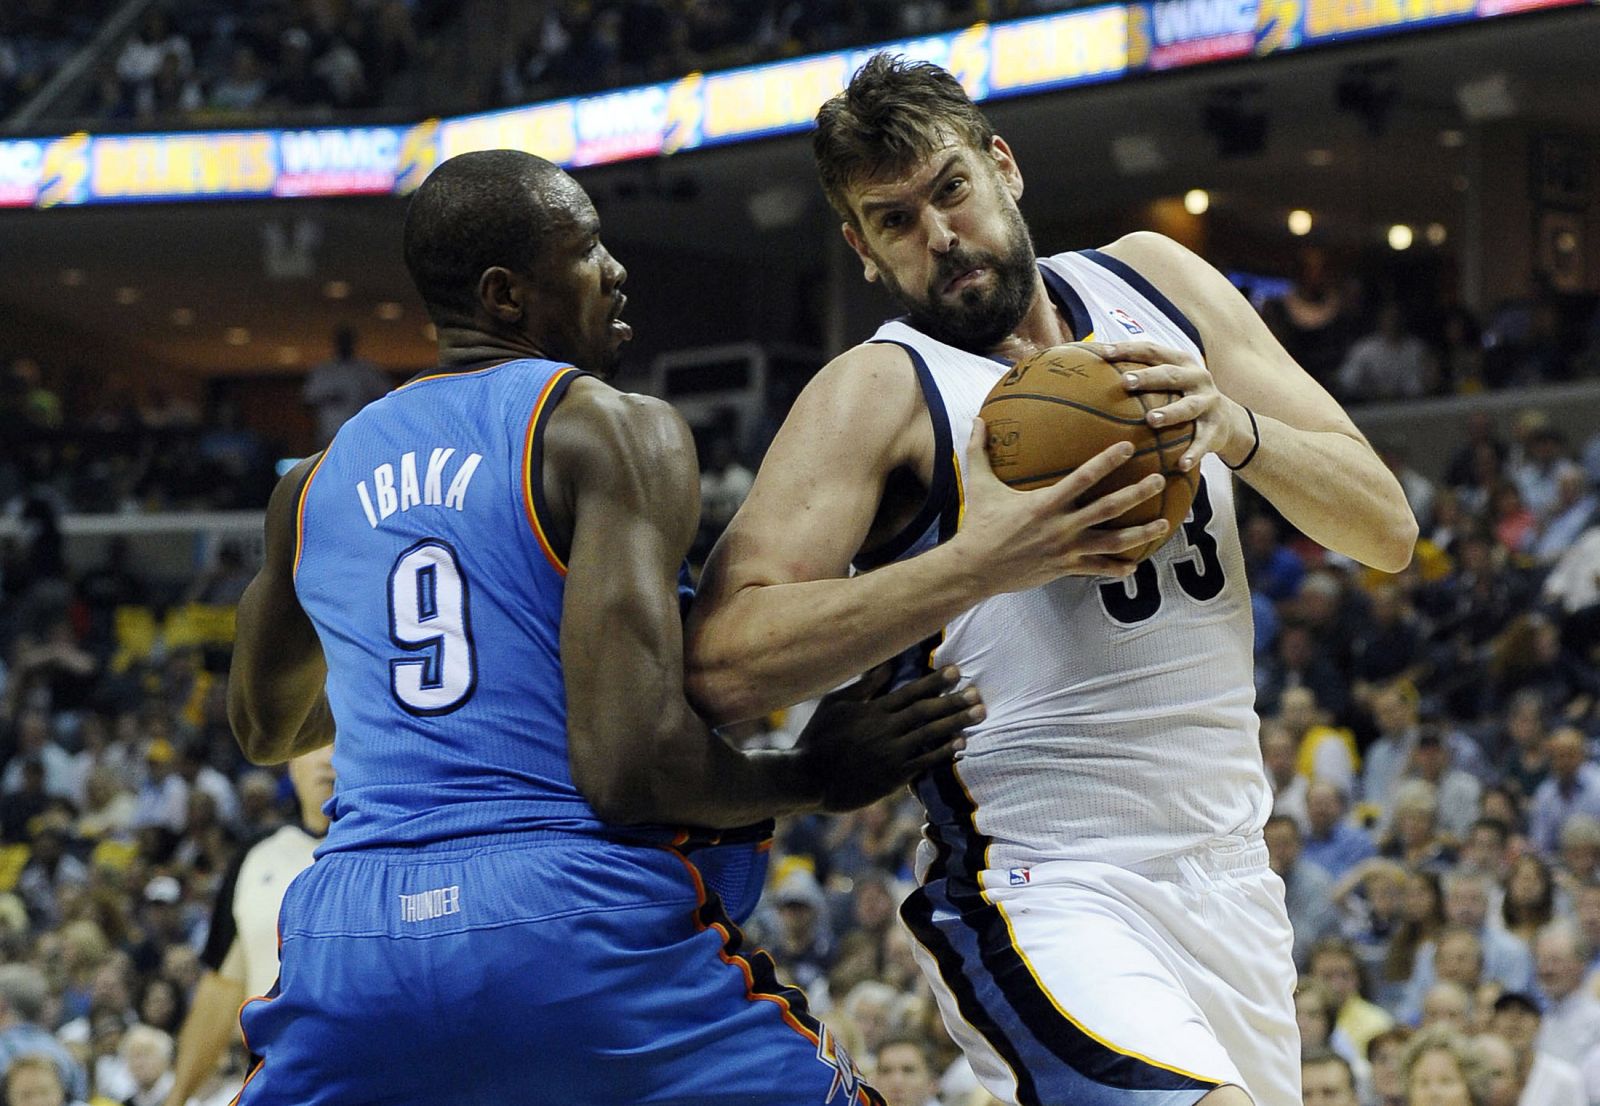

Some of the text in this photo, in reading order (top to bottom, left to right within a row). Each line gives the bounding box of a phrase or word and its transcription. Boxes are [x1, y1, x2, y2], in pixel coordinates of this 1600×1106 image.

[356, 447, 482, 528] IBAKA
[387, 536, 478, 717] 9
[398, 885, 461, 923] THUNDER
